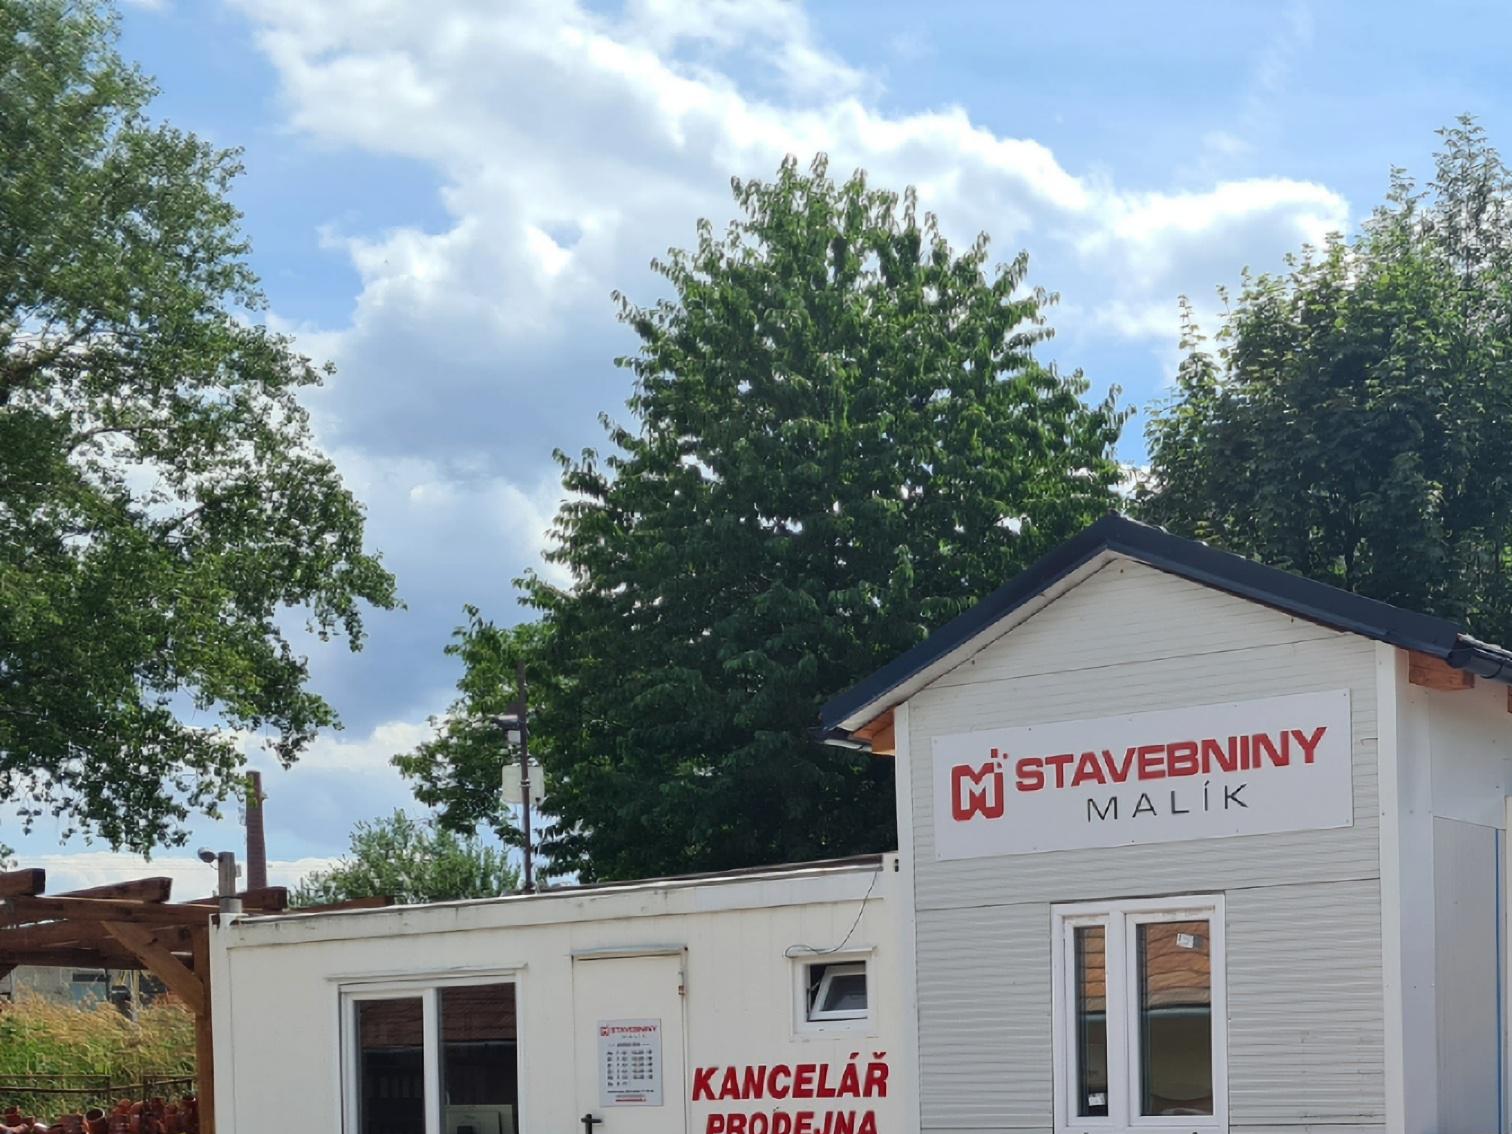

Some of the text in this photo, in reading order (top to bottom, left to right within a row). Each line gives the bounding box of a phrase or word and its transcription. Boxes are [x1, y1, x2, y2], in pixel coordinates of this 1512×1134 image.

[1015, 726, 1327, 792] STAVEBNINY
[1086, 780, 1248, 823] MALÍK
[692, 1052, 889, 1100] KANCELÁŘ
